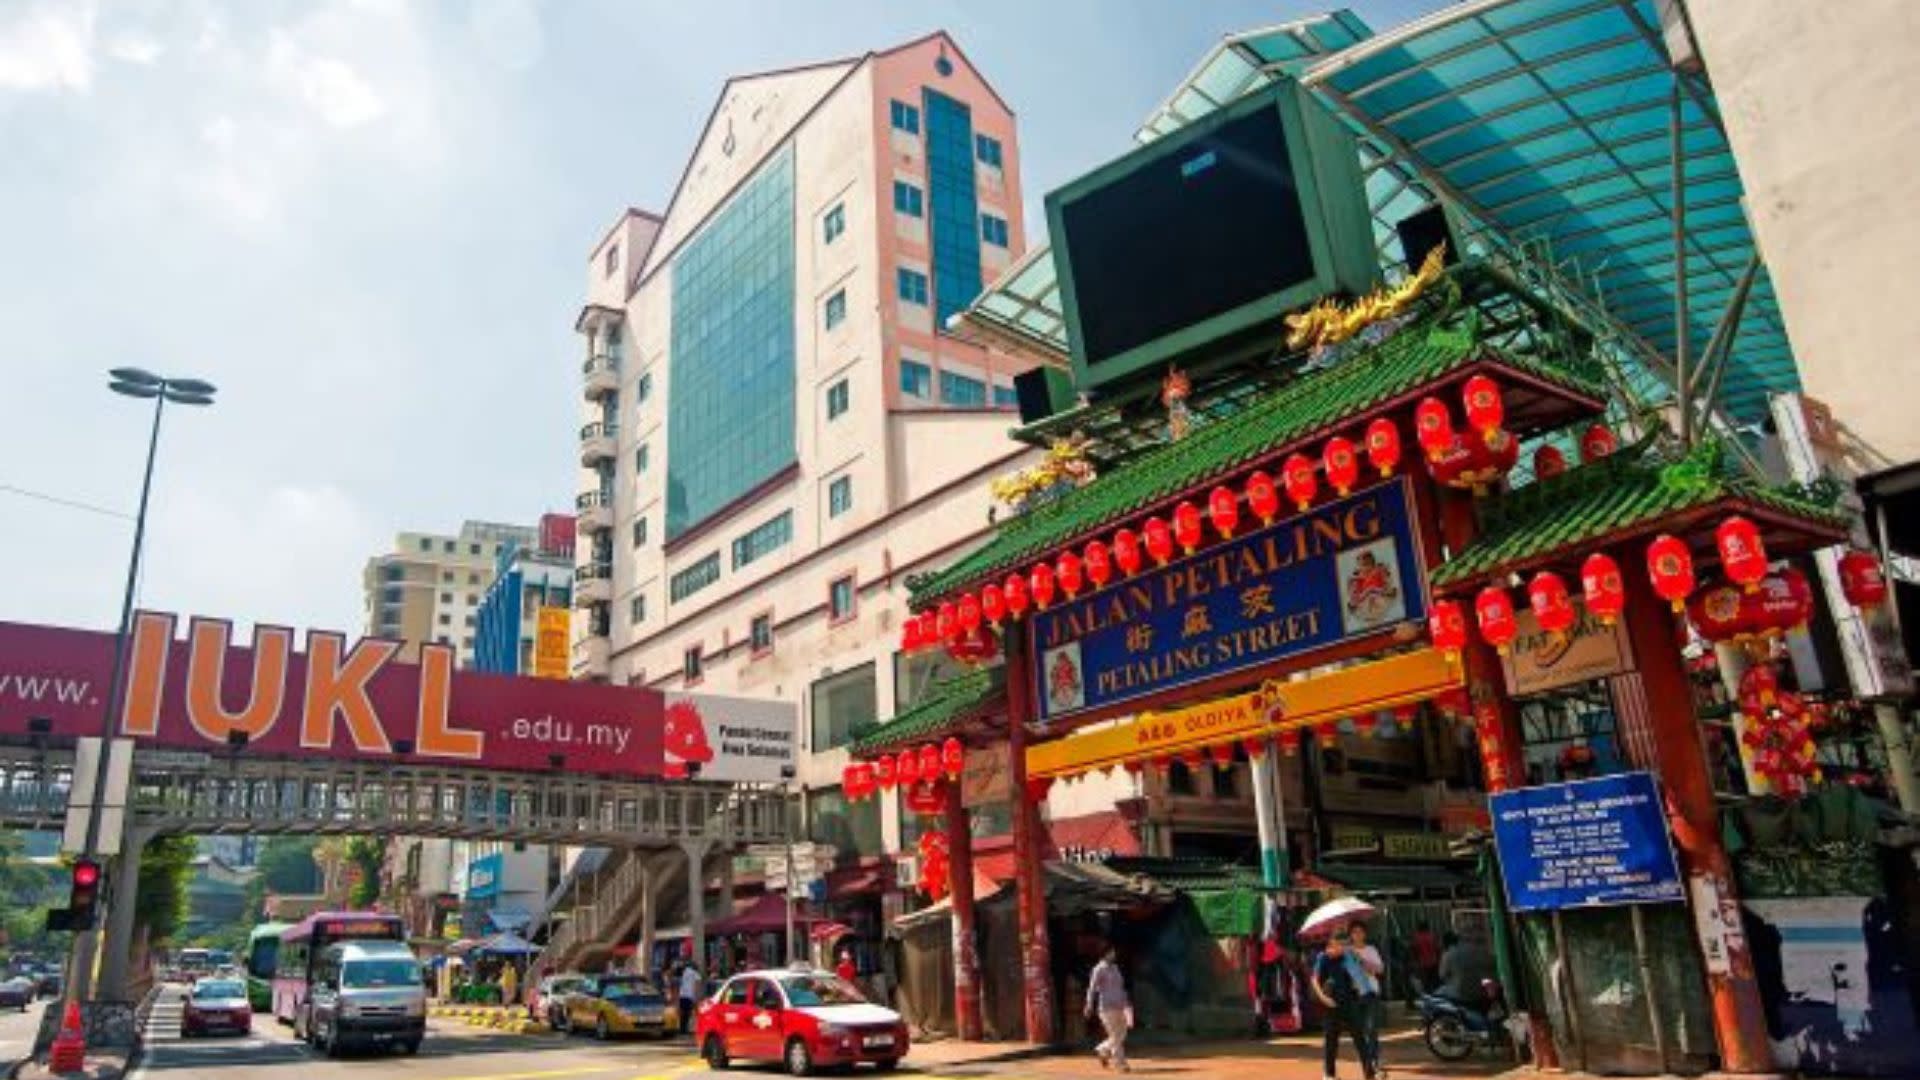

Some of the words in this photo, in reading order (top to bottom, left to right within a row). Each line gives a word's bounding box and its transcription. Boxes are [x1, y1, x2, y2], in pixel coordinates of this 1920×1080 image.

[1045, 579, 1152, 648] JALAN
[1165, 499, 1379, 605] PETALING
[1098, 641, 1210, 695] PETALING
[1215, 606, 1320, 663] STREET
[502, 716, 632, 751] .edu.my
